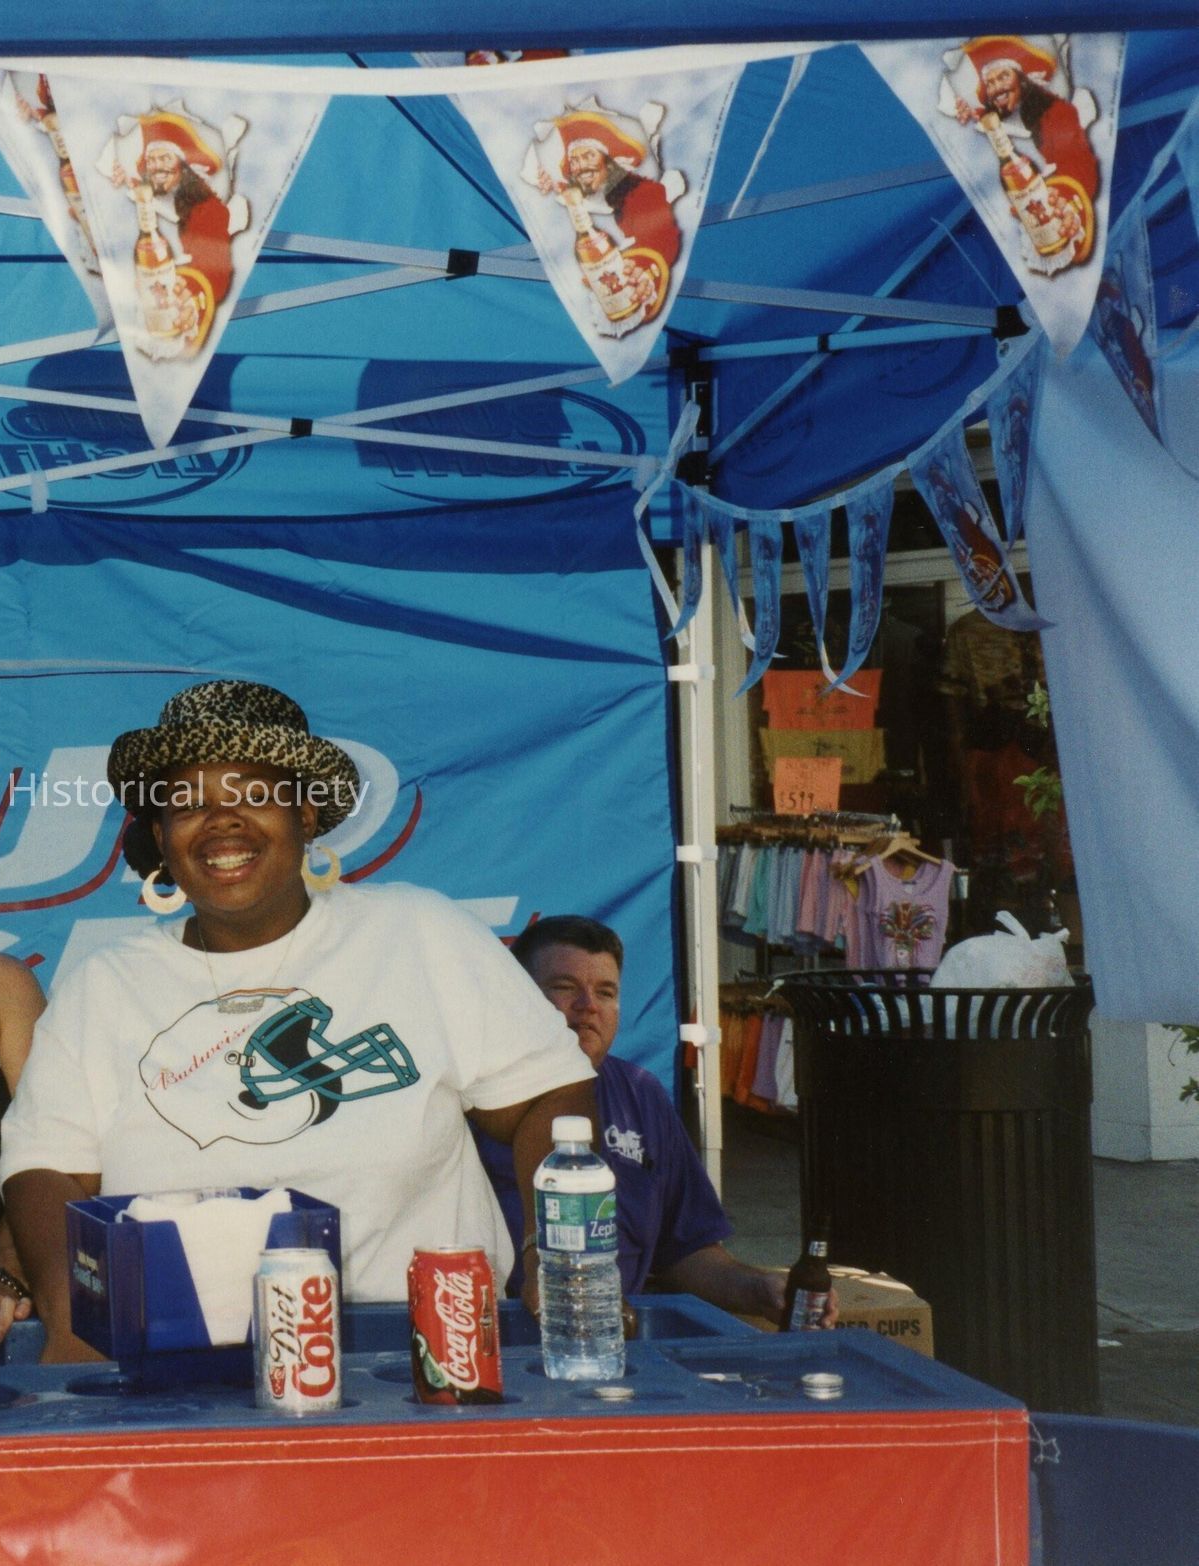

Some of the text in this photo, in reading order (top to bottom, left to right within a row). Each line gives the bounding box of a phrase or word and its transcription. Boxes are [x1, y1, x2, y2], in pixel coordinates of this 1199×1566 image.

[150, 1023, 250, 1091] Budweise
[268, 1284, 303, 1364] Diet
[291, 1274, 337, 1398] Coke
[433, 1268, 480, 1391] Coca-Cola
[876, 1318, 922, 1337] CUPS
